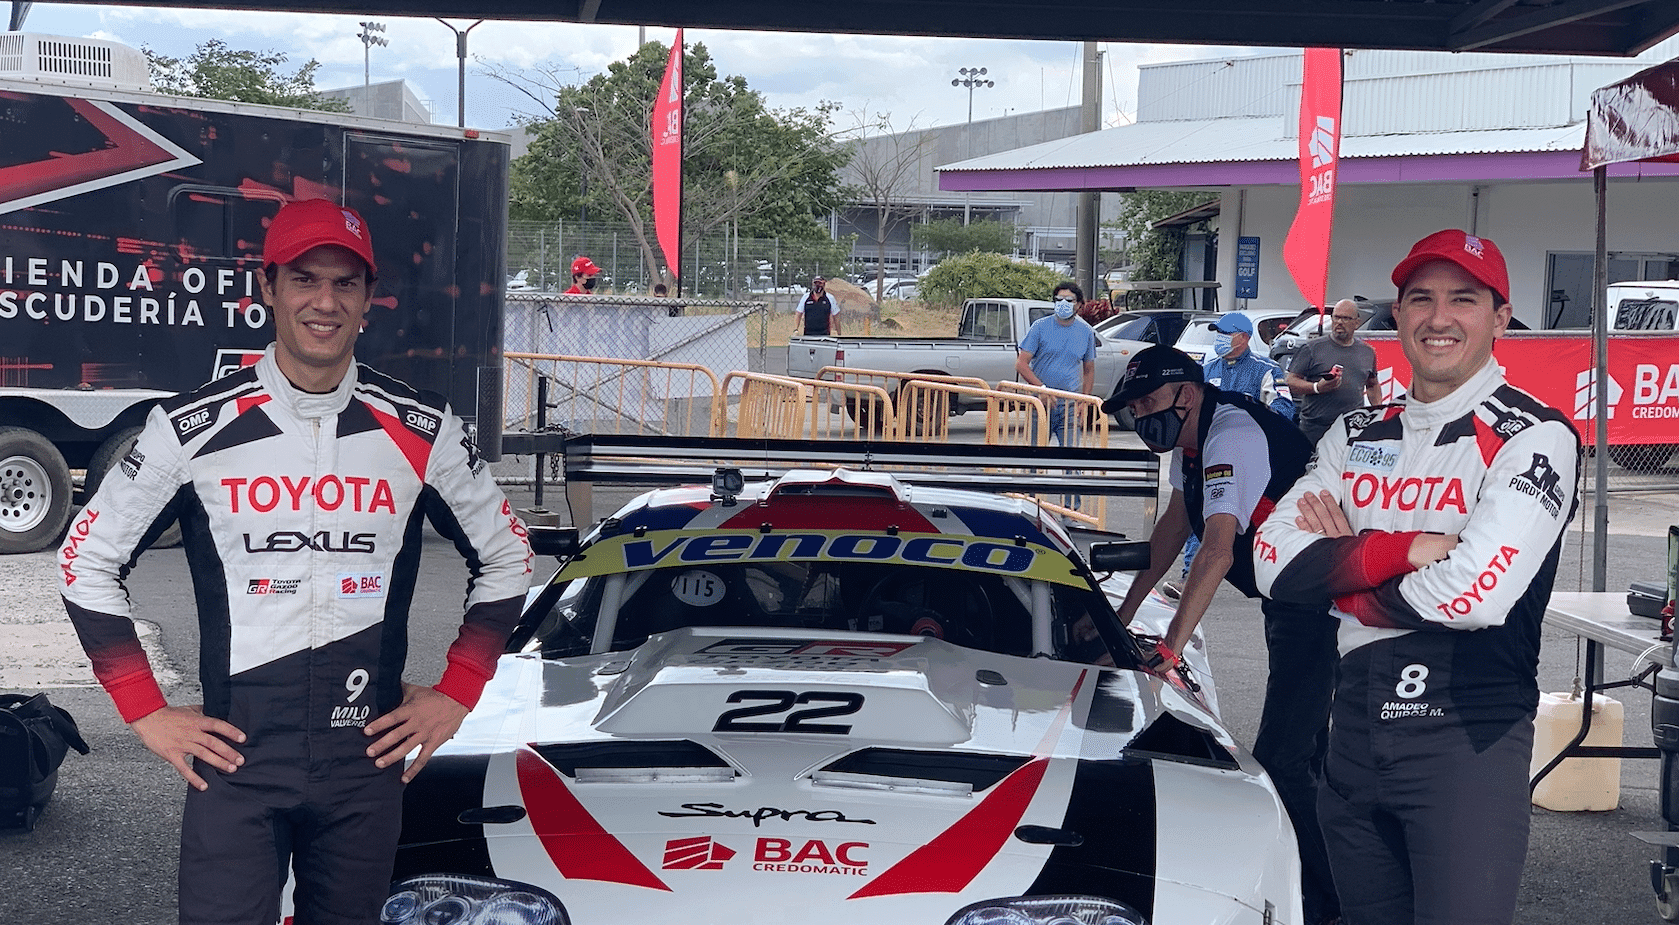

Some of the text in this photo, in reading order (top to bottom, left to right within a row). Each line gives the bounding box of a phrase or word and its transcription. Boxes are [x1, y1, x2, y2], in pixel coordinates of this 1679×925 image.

[1238, 267, 1256, 277] GOLF
[179, 411, 210, 431] OMP
[406, 413, 437, 431] OMP
[1350, 447, 1371, 463] ECO
[1381, 453, 1398, 466] 95
[220, 474, 397, 515] TOYOTA
[1210, 487, 1225, 500] 22
[1508, 477, 1560, 521] PURDY MOTOR
[60, 508, 100, 587] TOYOTA
[242, 530, 377, 554] LEXUS
[622, 533, 1036, 574] venoco
[247, 580, 270, 595] GR
[360, 576, 382, 589] BAC
[682, 577, 714, 598] 115
[1436, 546, 1520, 620] TOYOTA
[345, 668, 370, 703] 9
[1395, 663, 1429, 699] 8
[331, 705, 370, 720] MILO
[711, 690, 865, 735] 22
[1382, 702, 1429, 711] AMADEO
[1429, 708, 1445, 717] M.
[657, 803, 876, 827] Supra
[754, 838, 869, 866] BAC
[753, 863, 868, 876] CREDOMATIC
